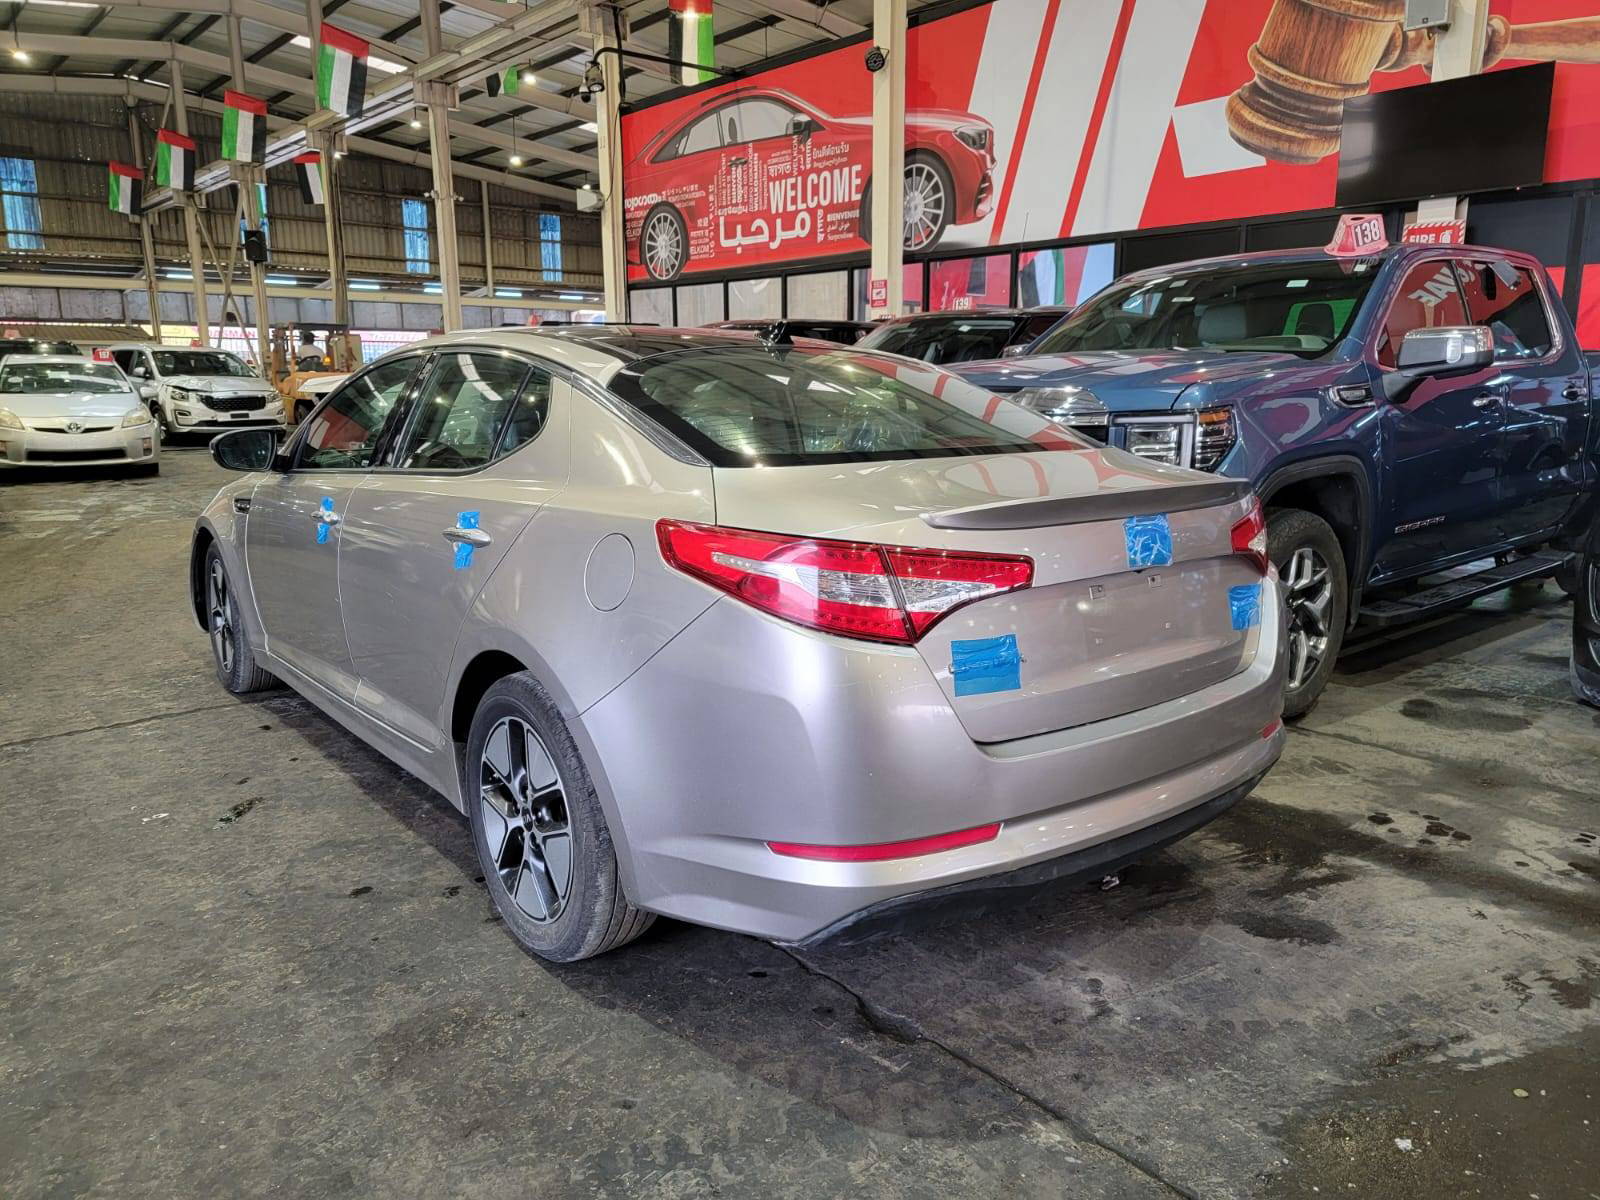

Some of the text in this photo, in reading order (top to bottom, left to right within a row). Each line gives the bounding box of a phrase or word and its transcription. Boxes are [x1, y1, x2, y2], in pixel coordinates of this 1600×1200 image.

[768, 164, 863, 214] WELCOME
[719, 211, 812, 255] مرحبا
[1354, 219, 1381, 246] 138
[1409, 233, 1436, 243] FIRE
[955, 296, 970, 311] 139
